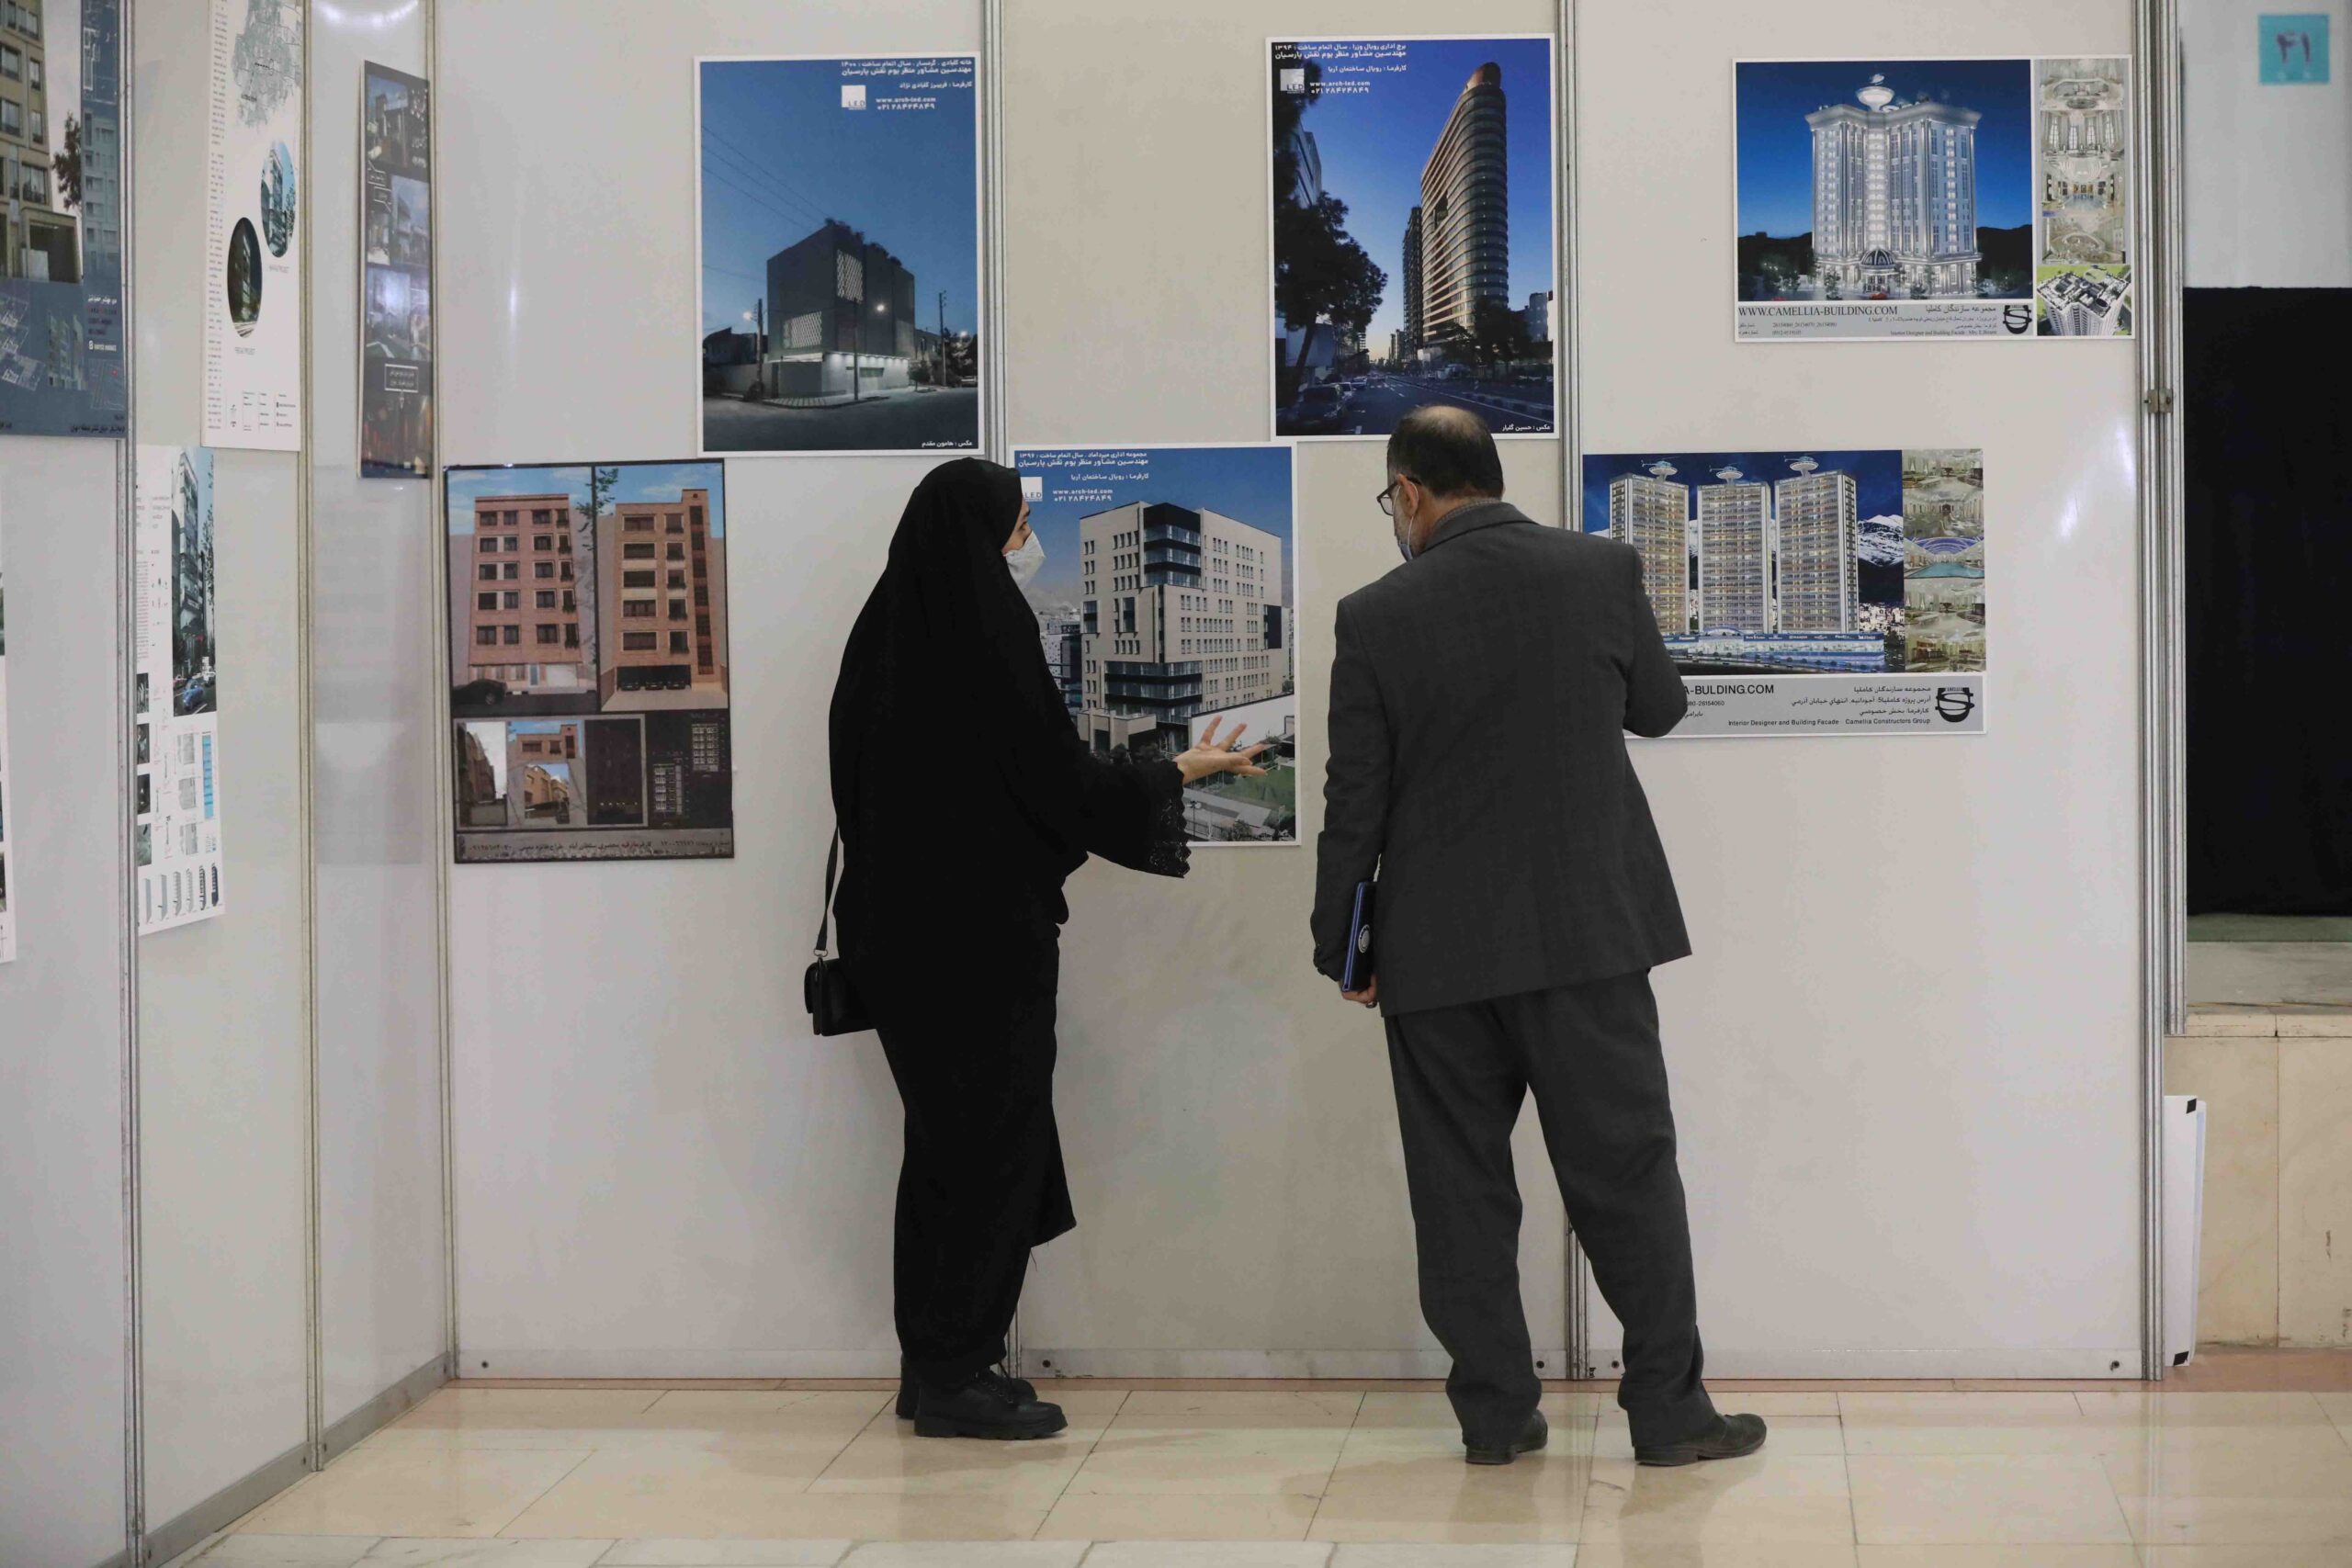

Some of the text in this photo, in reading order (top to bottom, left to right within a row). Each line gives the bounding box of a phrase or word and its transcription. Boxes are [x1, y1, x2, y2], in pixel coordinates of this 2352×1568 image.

[1275, 51, 1302, 60] پارسیان
[1304, 51, 1320, 59] نقش
[1335, 51, 1350, 59] منظر
[1739, 306, 1897, 316] WWW.CAMELLIA-BUILDING.COM
[1018, 459, 1045, 468] پارسیان
[1093, 458, 1115, 467] مشاور
